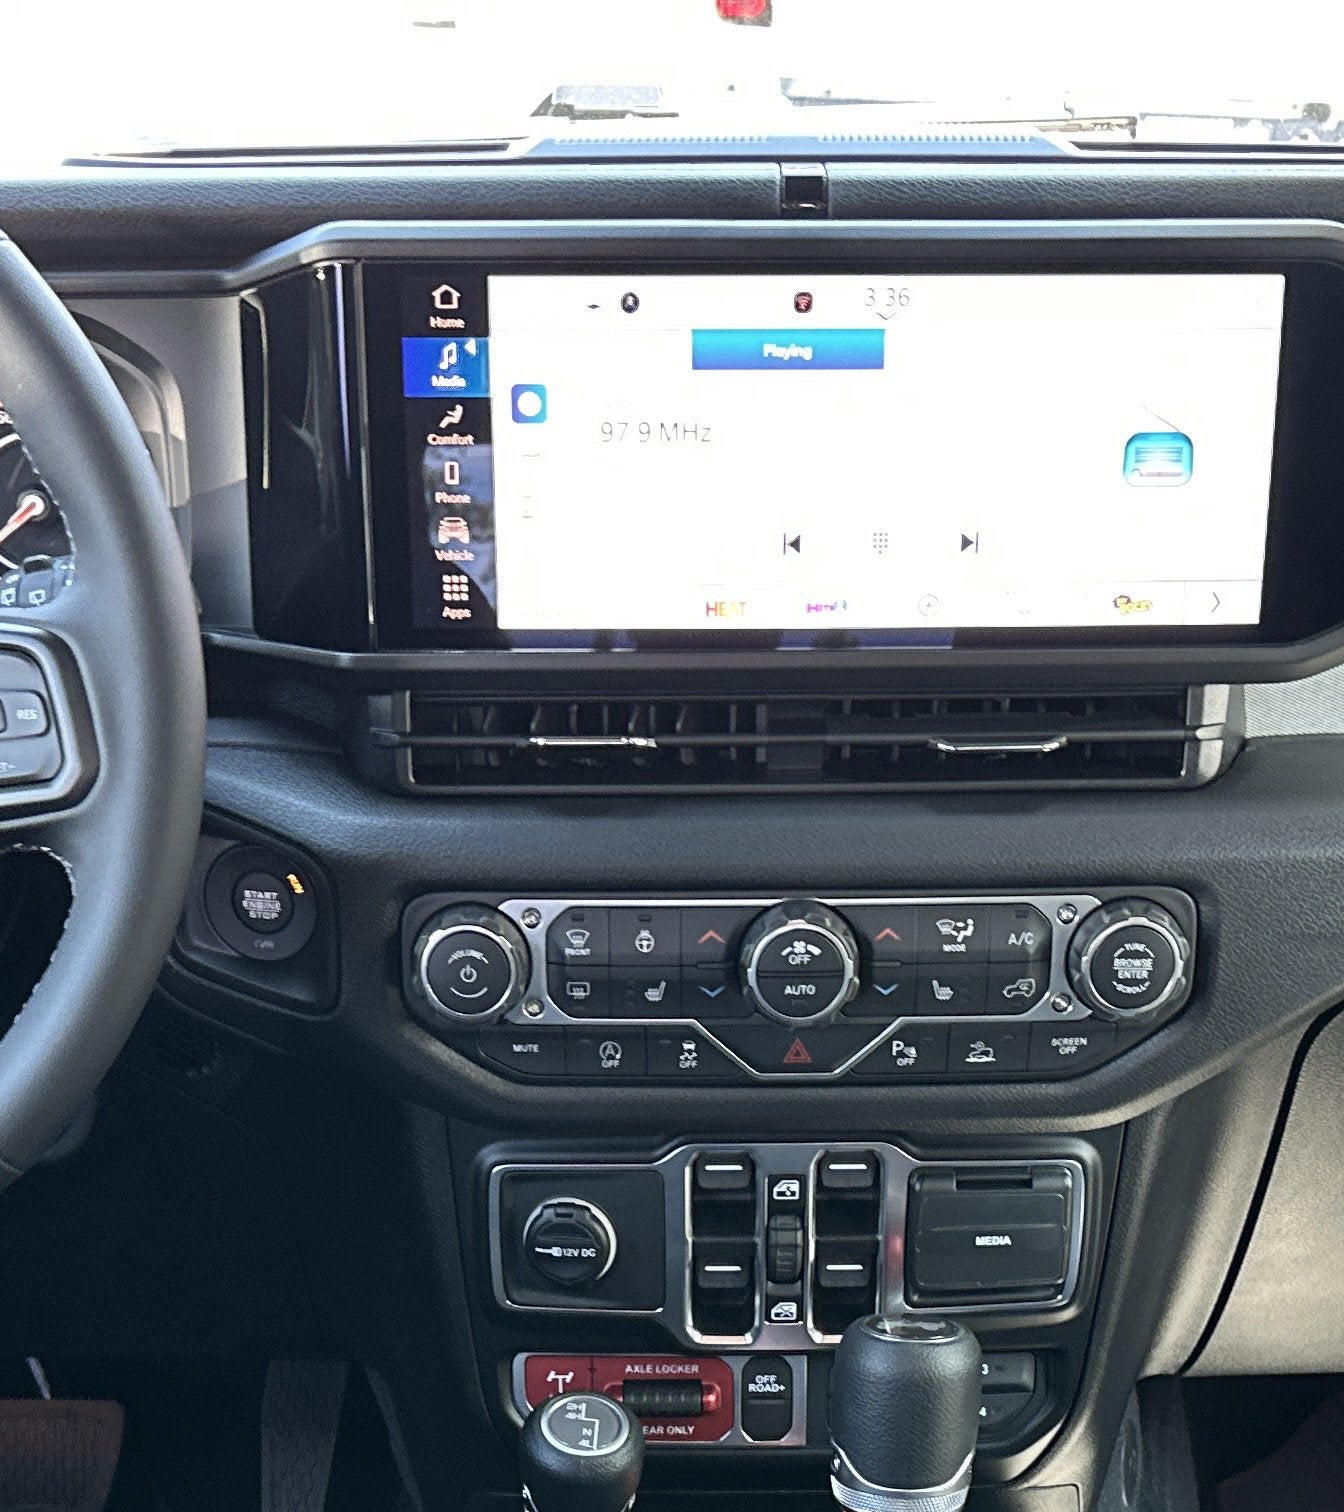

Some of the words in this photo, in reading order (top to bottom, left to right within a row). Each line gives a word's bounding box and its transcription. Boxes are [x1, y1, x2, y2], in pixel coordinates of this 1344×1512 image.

[865, 288, 910, 306] 336
[430, 316, 465, 329] Home
[763, 343, 812, 361] Playing
[431, 375, 467, 388] Media
[601, 422, 651, 442] 979
[660, 422, 711, 442] MHz
[427, 434, 474, 446] Comfort
[435, 492, 472, 504] Phone
[435, 549, 475, 561] Vehicle
[442, 607, 472, 619] Apps
[16, 708, 38, 721] RES
[243, 889, 278, 900] START
[249, 910, 279, 920] STOP
[1008, 933, 1035, 945] A/C
[788, 955, 812, 966] OFF
[1113, 957, 1153, 968] BROWSE
[1117, 969, 1149, 980] ENTER
[784, 984, 817, 996] AUTO
[1051, 1037, 1088, 1047] SCREEN
[513, 1044, 540, 1053] MUTE
[1058, 1046, 1078, 1055] OFF
[601, 1060, 620, 1069] OFF
[679, 1060, 698, 1069] OFF
[896, 1057, 916, 1067] OFF
[975, 1235, 1012, 1246] MEDIA
[625, 1364, 653, 1374] AXLE
[656, 1364, 699, 1374] LOCKER
[981, 1363, 989, 1375] 3
[755, 1375, 777, 1384] OFF
[978, 1406, 987, 1417] 4
[582, 1427, 593, 1436] N
[641, 1426, 664, 1436] EAR
[666, 1426, 695, 1436] ONLY
